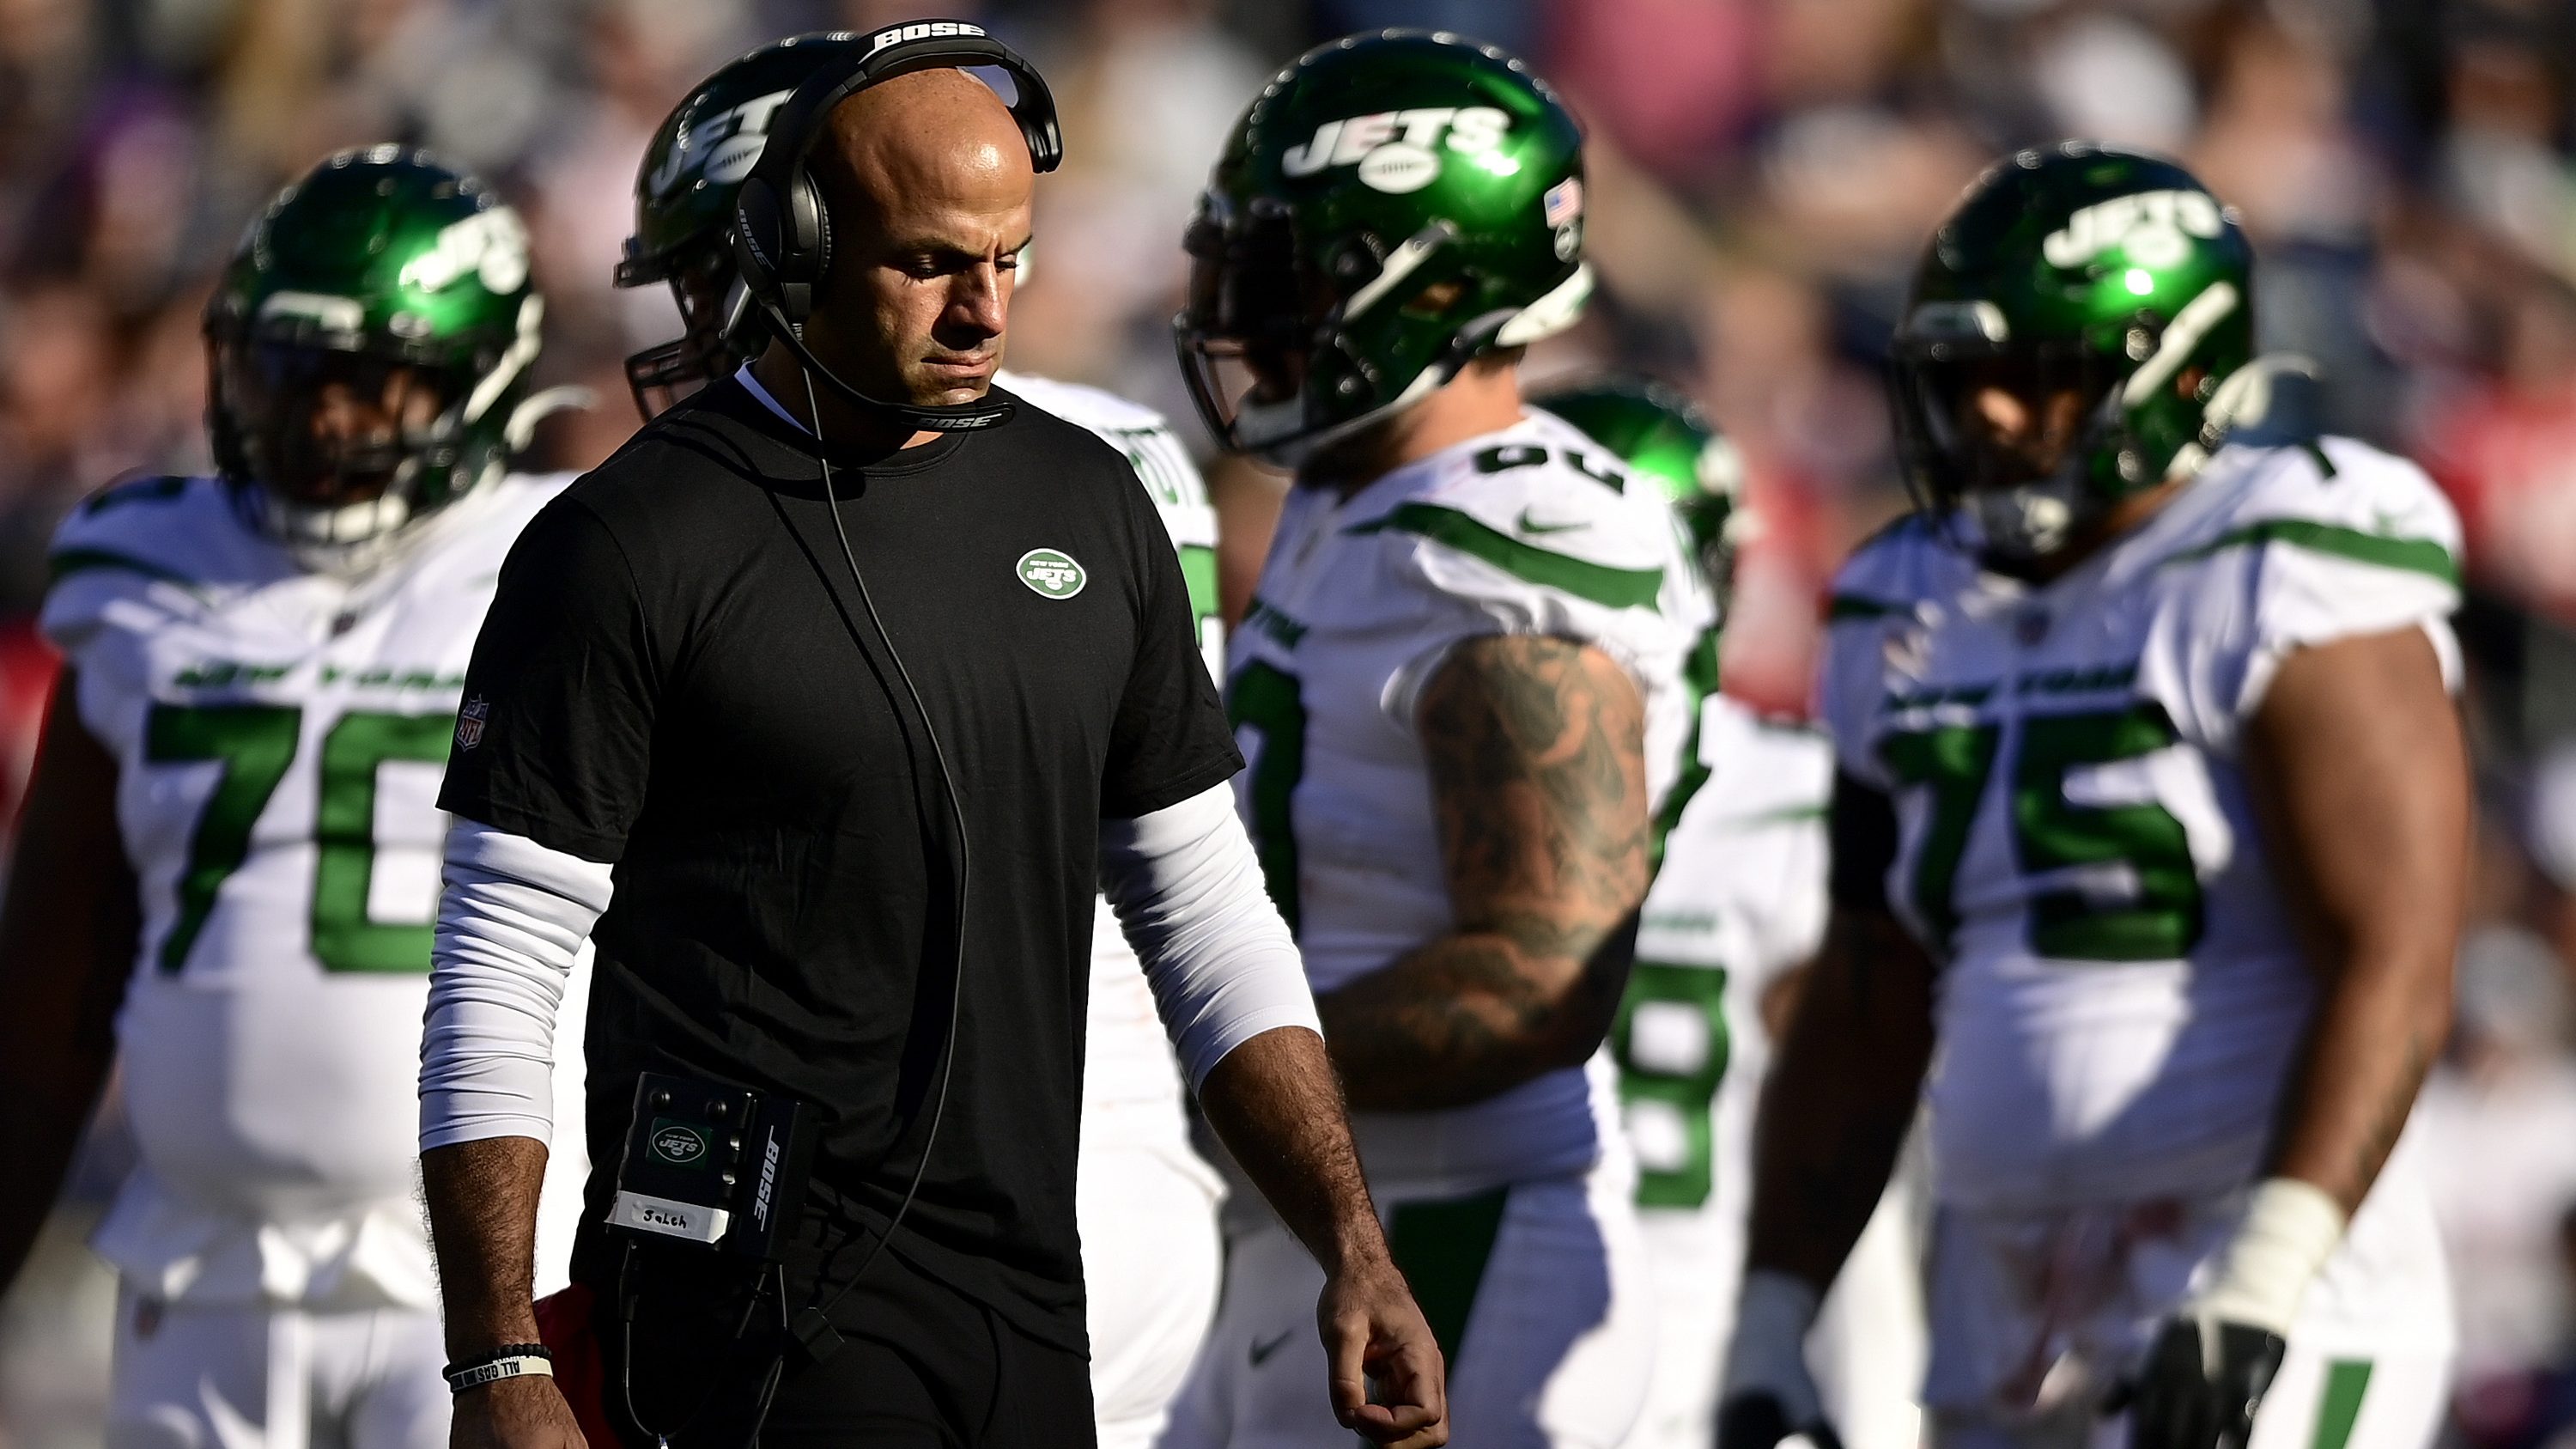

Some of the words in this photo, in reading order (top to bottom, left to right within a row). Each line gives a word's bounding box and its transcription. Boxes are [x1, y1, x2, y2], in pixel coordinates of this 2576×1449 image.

[858, 22, 987, 64] BOSE
[649, 88, 799, 198] JET
[1282, 107, 1513, 177] JETS
[738, 209, 775, 270] BOSE
[915, 412, 1003, 429] BOSE
[1026, 568, 1077, 583] JETS
[144, 703, 459, 976] 70
[1875, 697, 2203, 964] 75
[659, 1139, 699, 1152] JETS
[753, 1125, 780, 1232] BOSE
[477, 1364, 498, 1382] GAS
[501, 1361, 520, 1376] ALL
